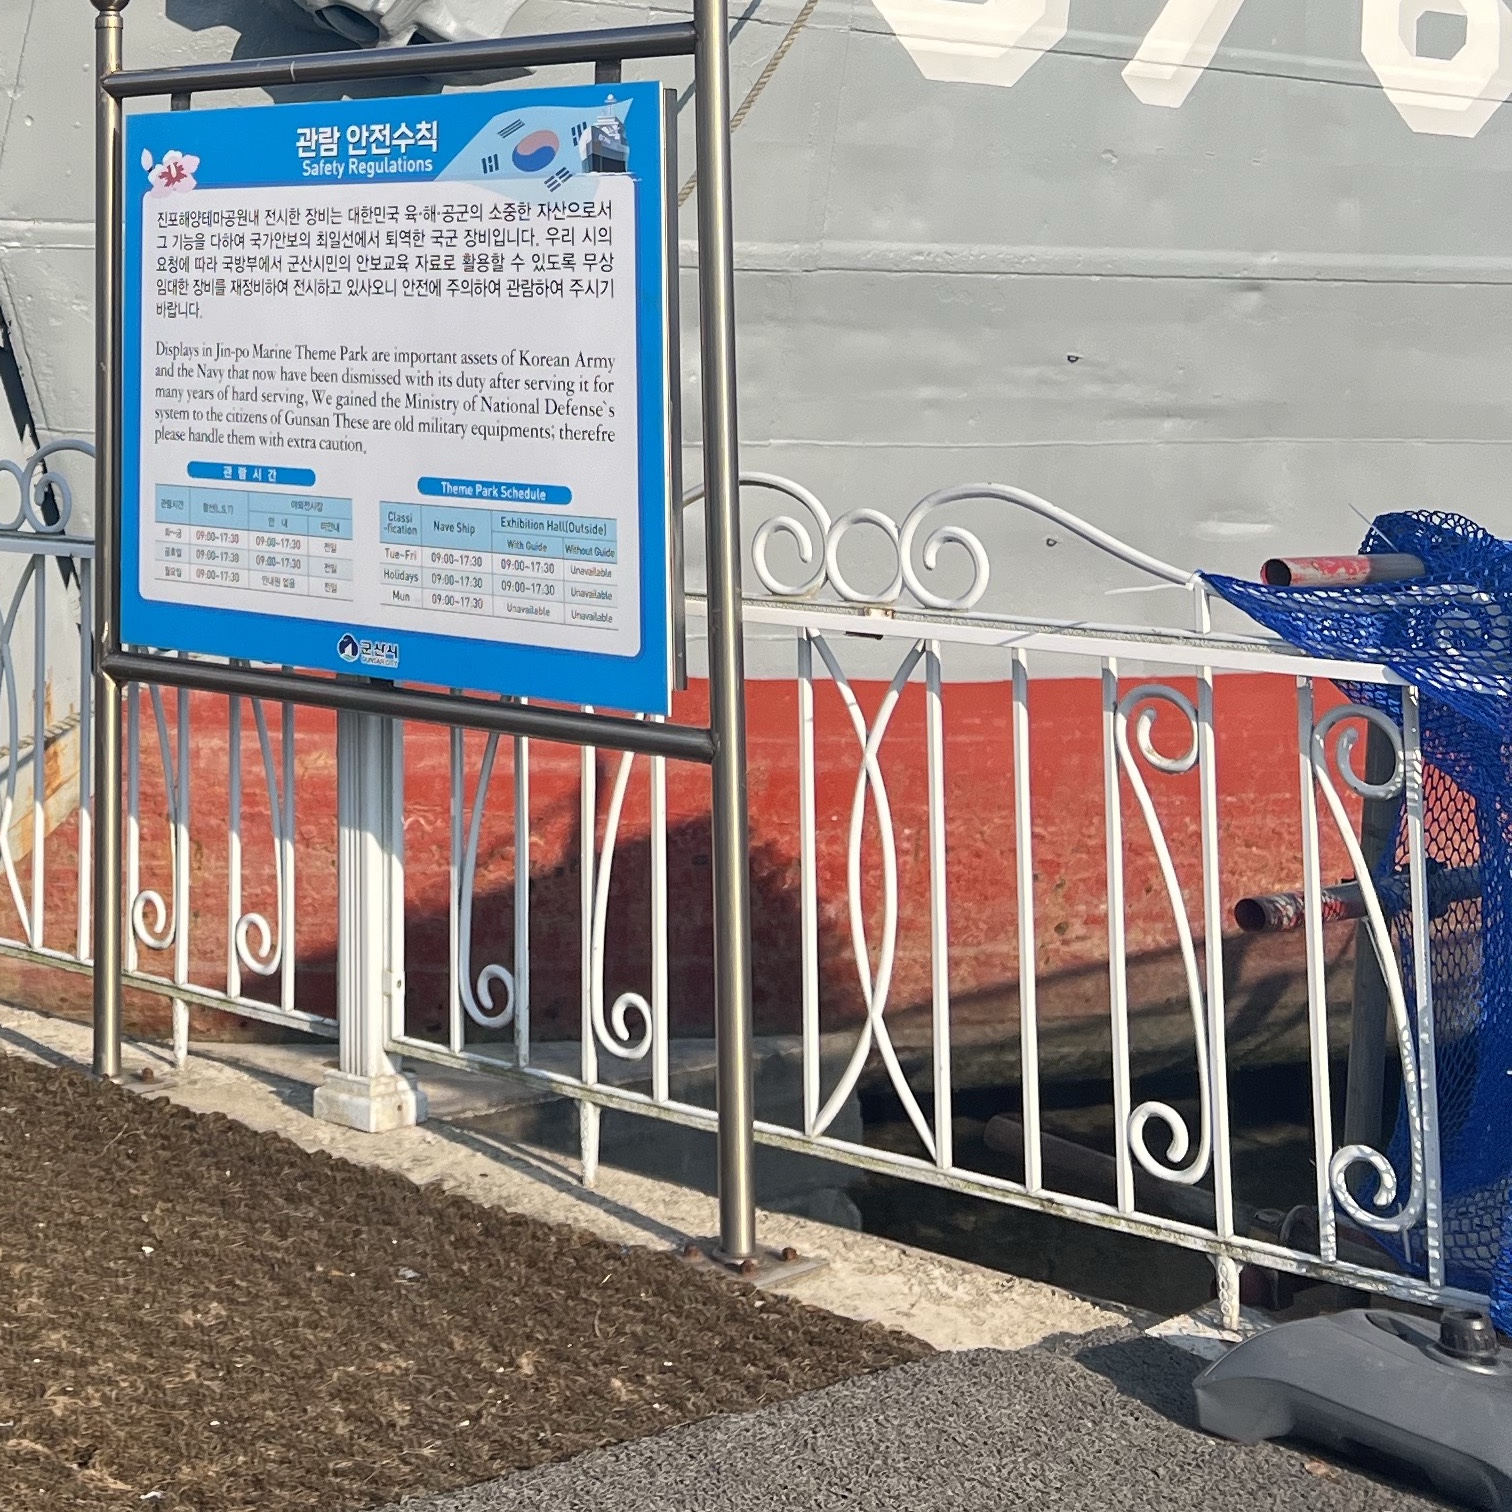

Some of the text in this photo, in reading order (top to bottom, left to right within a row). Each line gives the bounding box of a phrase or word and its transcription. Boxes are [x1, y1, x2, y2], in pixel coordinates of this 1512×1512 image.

[295, 120, 437, 158] 관람 안전수칙
[302, 156, 433, 179] Safety Regulations
[156, 208, 259, 229] 진포해양테마공원내
[263, 207, 301, 226] 전시한
[304, 206, 343, 226] 장비는
[347, 205, 400, 224] 대한민국
[487, 201, 532, 222] 소중한
[536, 199, 612, 221] 자산으로서
[156, 225, 612, 251] 그 기능을 다하여 국가안보의 최일선에서 퇴역한 국군 장비입니다. 우리 시의
[155, 251, 614, 273] 요청에 따라 국방부에서 군산시민의 안보교육 자료로 활용할 수 있도록 무상
[156, 277, 614, 299] 임대한 장비를 재정비하여 전시하고 있사오니 안전에 주의하여 관람하여 주시기
[155, 300, 203, 319] 바랍니다.
[155, 340, 616, 374] Displays in Jin-po Marine Theme Park are important assets of Korean Army
[154, 361, 615, 397] and the Navy that now have been dismissed with its duty after serving it for
[154, 387, 184, 403] many
[186, 388, 214, 404] years
[216, 384, 230, 400] of
[231, 385, 258, 402] hard
[311, 388, 332, 406] We
[335, 389, 377, 411] gained
[380, 391, 401, 408] the
[404, 392, 459, 416] Ministry
[462, 393, 478, 412] of
[479, 392, 539, 415] National
[154, 408, 190, 423] system
[192, 409, 204, 421] to
[205, 405, 223, 422] the
[225, 406, 267, 424] citizens
[269, 408, 284, 425] of
[284, 409, 330, 428] Gunsan
[332, 409, 369, 430] These
[372, 419, 391, 431] are
[394, 414, 414, 432] old
[417, 414, 468, 440] military
[559, 422, 616, 442] therefre
[154, 424, 186, 444] please
[188, 426, 224, 444] handle
[226, 428, 255, 445] them
[258, 430, 284, 447] with
[286, 437, 316, 449] extra
[440, 481, 546, 500] Theme Park Schedule
[387, 510, 413, 523] Classi
[500, 515, 606, 536] Exhibition Hall(Outside)
[433, 520, 475, 536] Nave Ship
[506, 539, 547, 552] With Guide
[383, 568, 419, 584] Holidays
